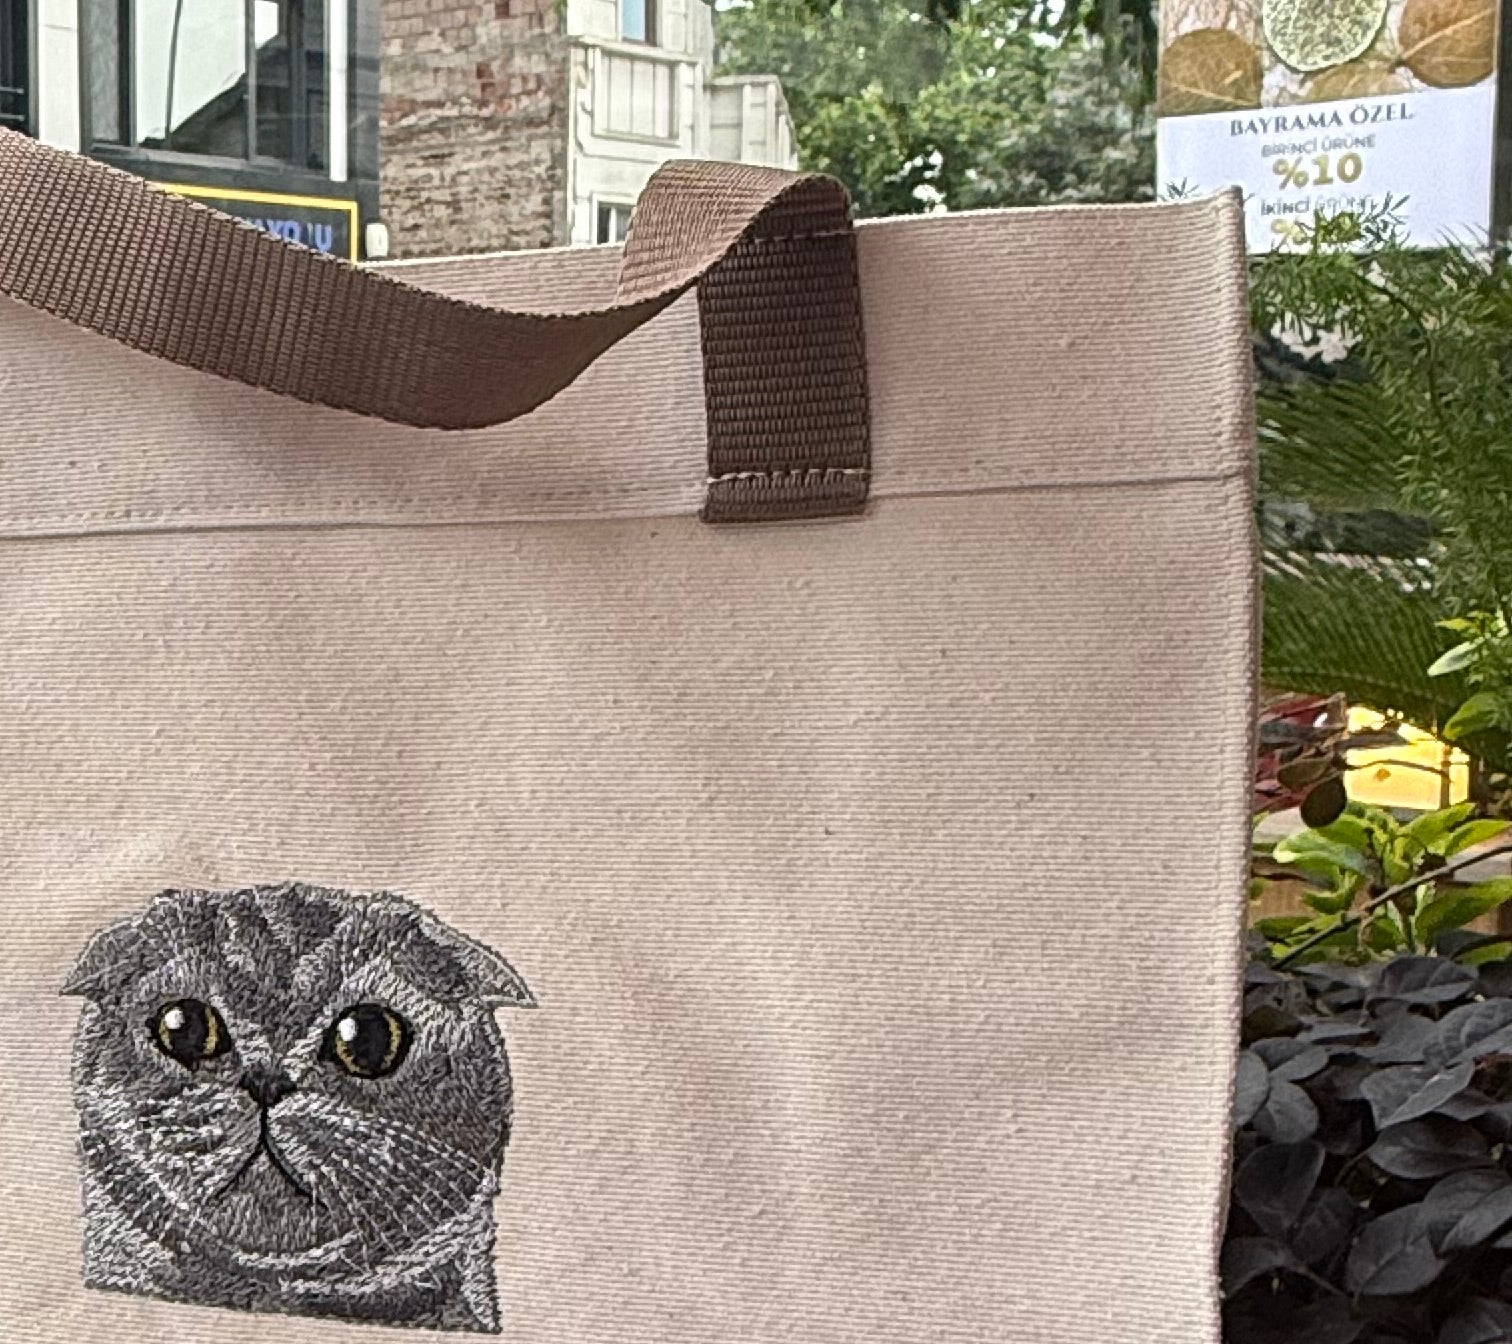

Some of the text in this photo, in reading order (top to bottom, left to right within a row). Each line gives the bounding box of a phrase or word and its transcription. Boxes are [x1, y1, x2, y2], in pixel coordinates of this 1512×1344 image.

[1230, 103, 1415, 137] BAYRAMA ÖZEL
[1272, 152, 1364, 190] %10
